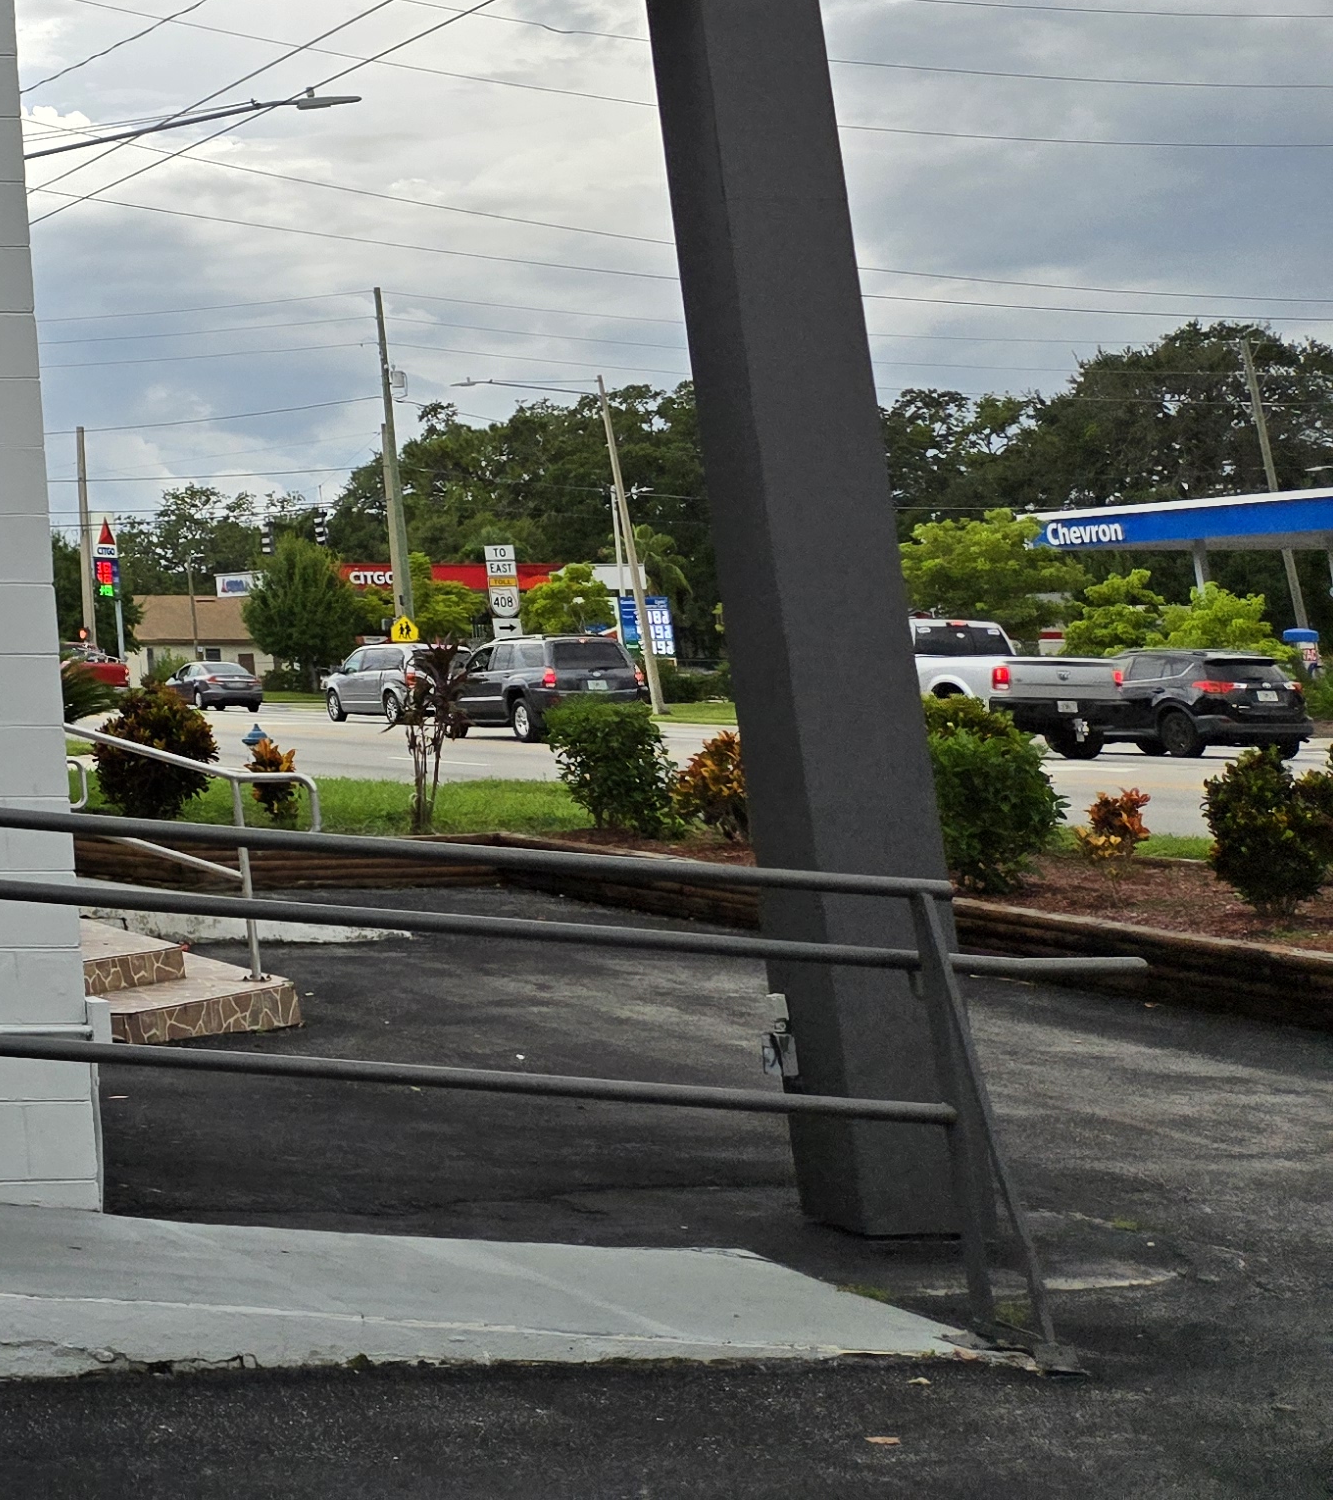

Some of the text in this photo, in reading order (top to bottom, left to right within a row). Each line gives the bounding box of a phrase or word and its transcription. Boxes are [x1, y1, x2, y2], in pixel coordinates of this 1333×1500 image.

[1046, 522, 1123, 546] Chevron
[493, 548, 506, 557] TO
[490, 563, 512, 573] EAST
[493, 596, 513, 608] 408
